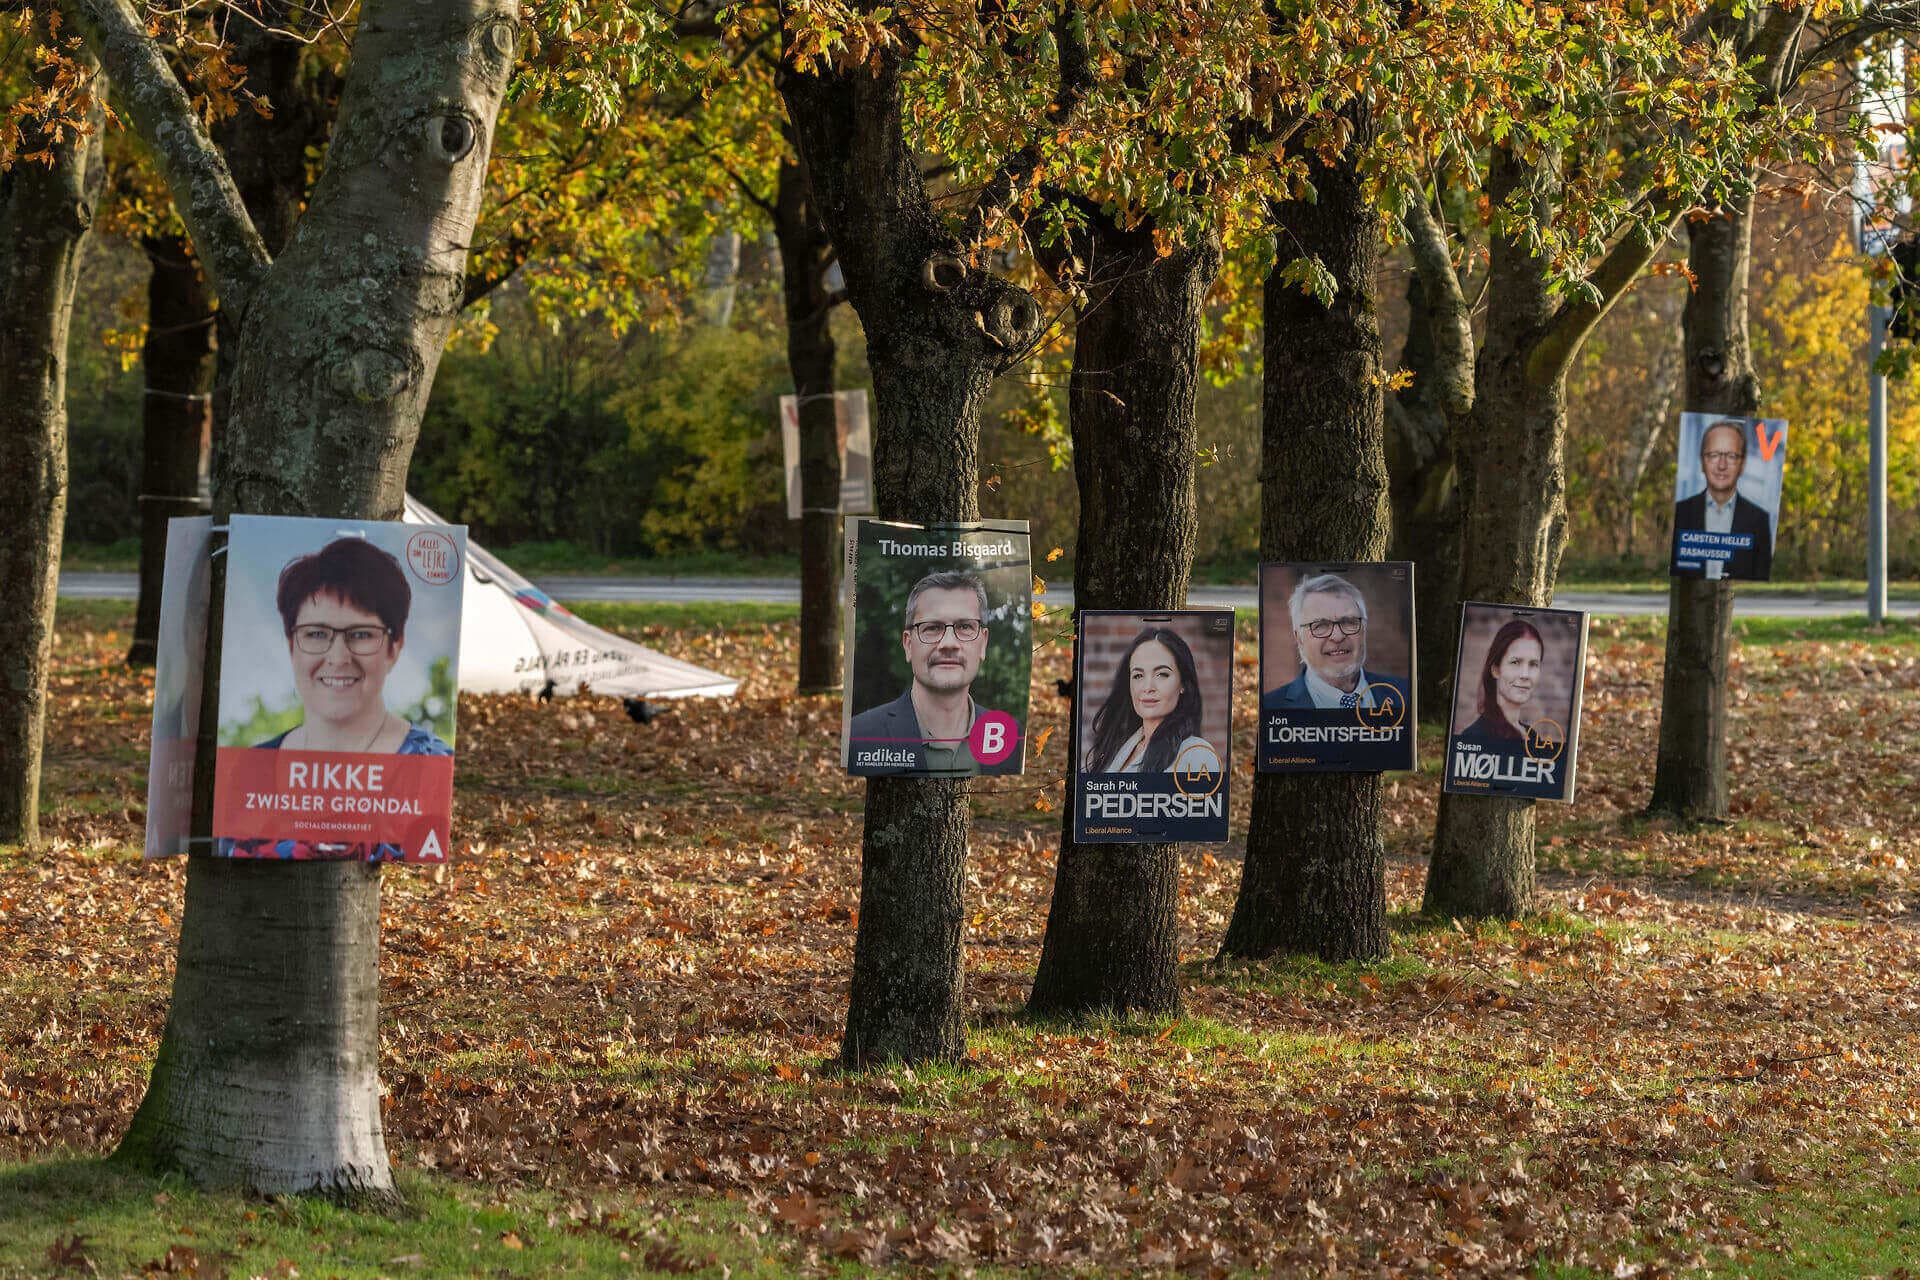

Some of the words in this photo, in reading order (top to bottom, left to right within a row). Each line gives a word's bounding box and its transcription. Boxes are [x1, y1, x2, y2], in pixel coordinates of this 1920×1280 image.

[1755, 422, 1783, 463] V
[1681, 532, 1720, 545] CARSTEN
[1721, 535, 1751, 547] HELLES
[878, 539, 948, 558] Thomas
[952, 540, 1013, 560] Bisgaard
[1679, 546, 1732, 559] RASMUSSEN
[1369, 697, 1394, 717] LA
[1268, 716, 1288, 726] Jon
[982, 722, 1006, 754] B
[1269, 726, 1404, 743] LORENTSFELDT
[1535, 732, 1554, 750] LA
[857, 748, 916, 763] radikale
[1456, 741, 1482, 752] Susan
[289, 761, 384, 792] RIKKE
[1186, 763, 1212, 782] LA
[1454, 752, 1556, 784] MØLLER
[1086, 780, 1116, 791] Sarah
[1118, 780, 1138, 791] Puk
[245, 793, 324, 811] ZWISLER
[331, 796, 423, 815] GRØNDAL
[1085, 793, 1222, 818] PEDERSEN
[294, 821, 372, 832] SOCIALDEMOKRATIET
[418, 828, 443, 859] A
